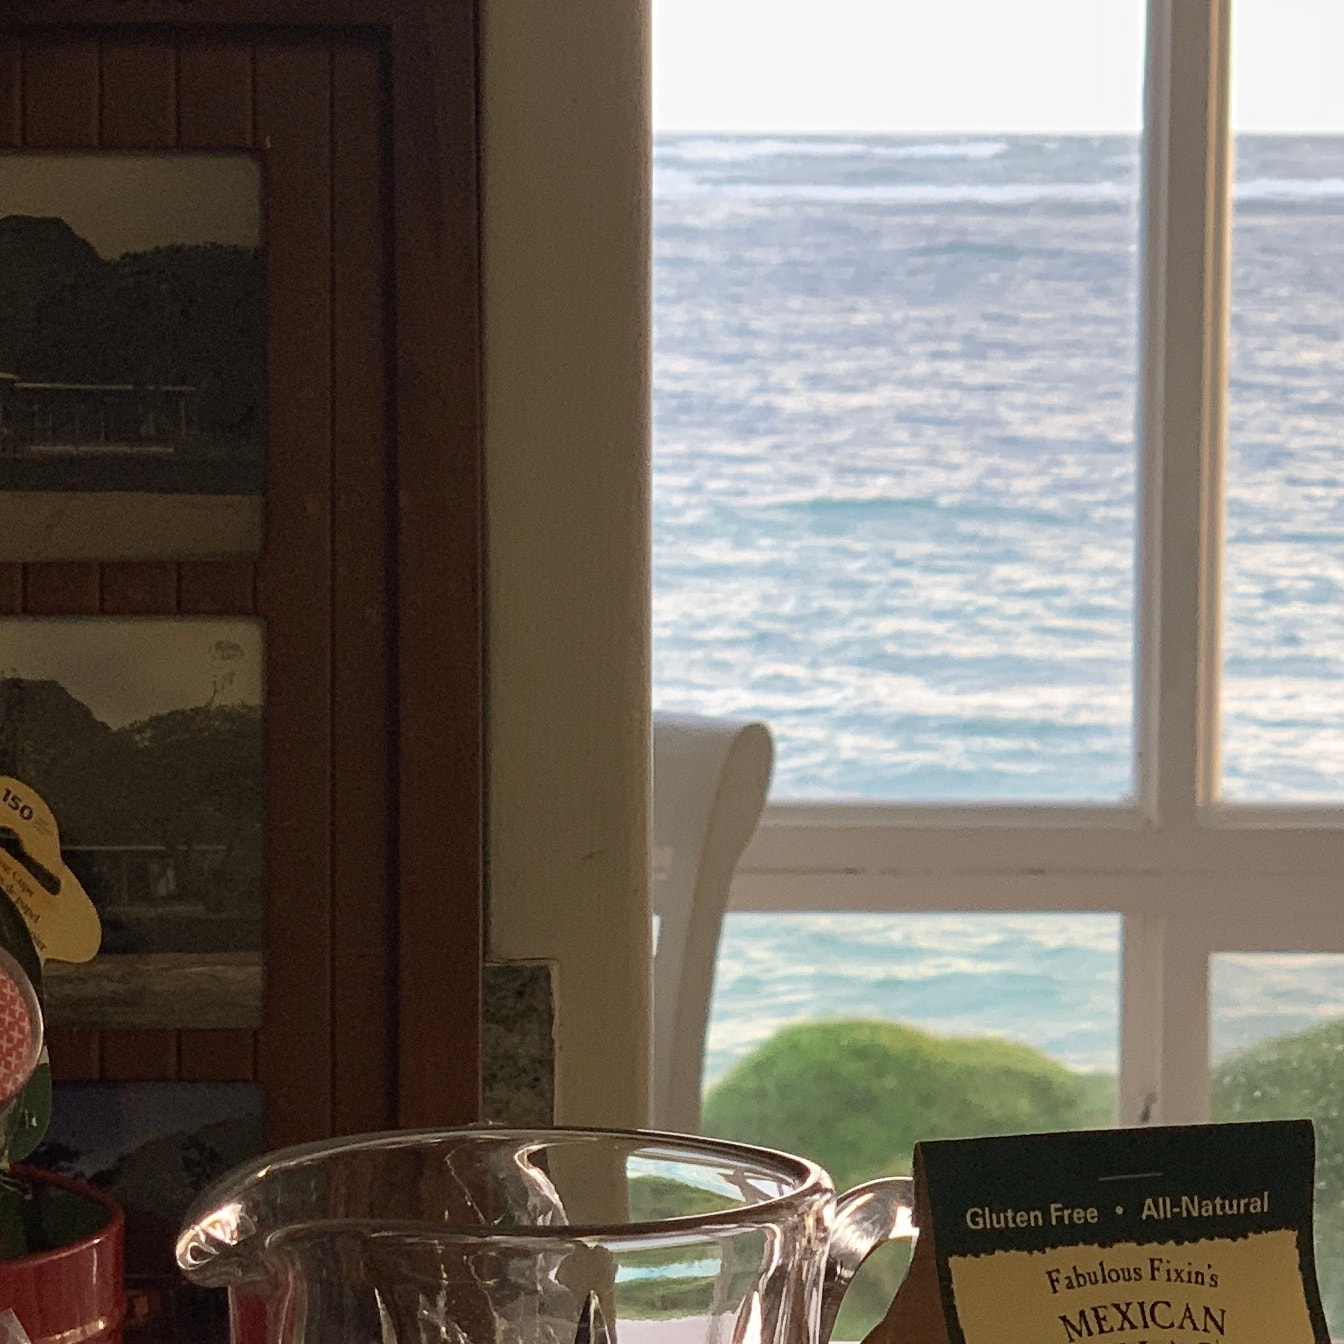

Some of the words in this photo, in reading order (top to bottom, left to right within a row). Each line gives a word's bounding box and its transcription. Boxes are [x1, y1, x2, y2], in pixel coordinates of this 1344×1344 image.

[2, 788, 33, 820] 150
[966, 1207, 1043, 1231] Gluten
[1050, 1203, 1099, 1225] Free
[1141, 1191, 1270, 1220] All-Natural
[1046, 1261, 1143, 1294] Fabulous
[1149, 1258, 1219, 1288] Fixin's
[1059, 1300, 1227, 1343] MEXICAN
